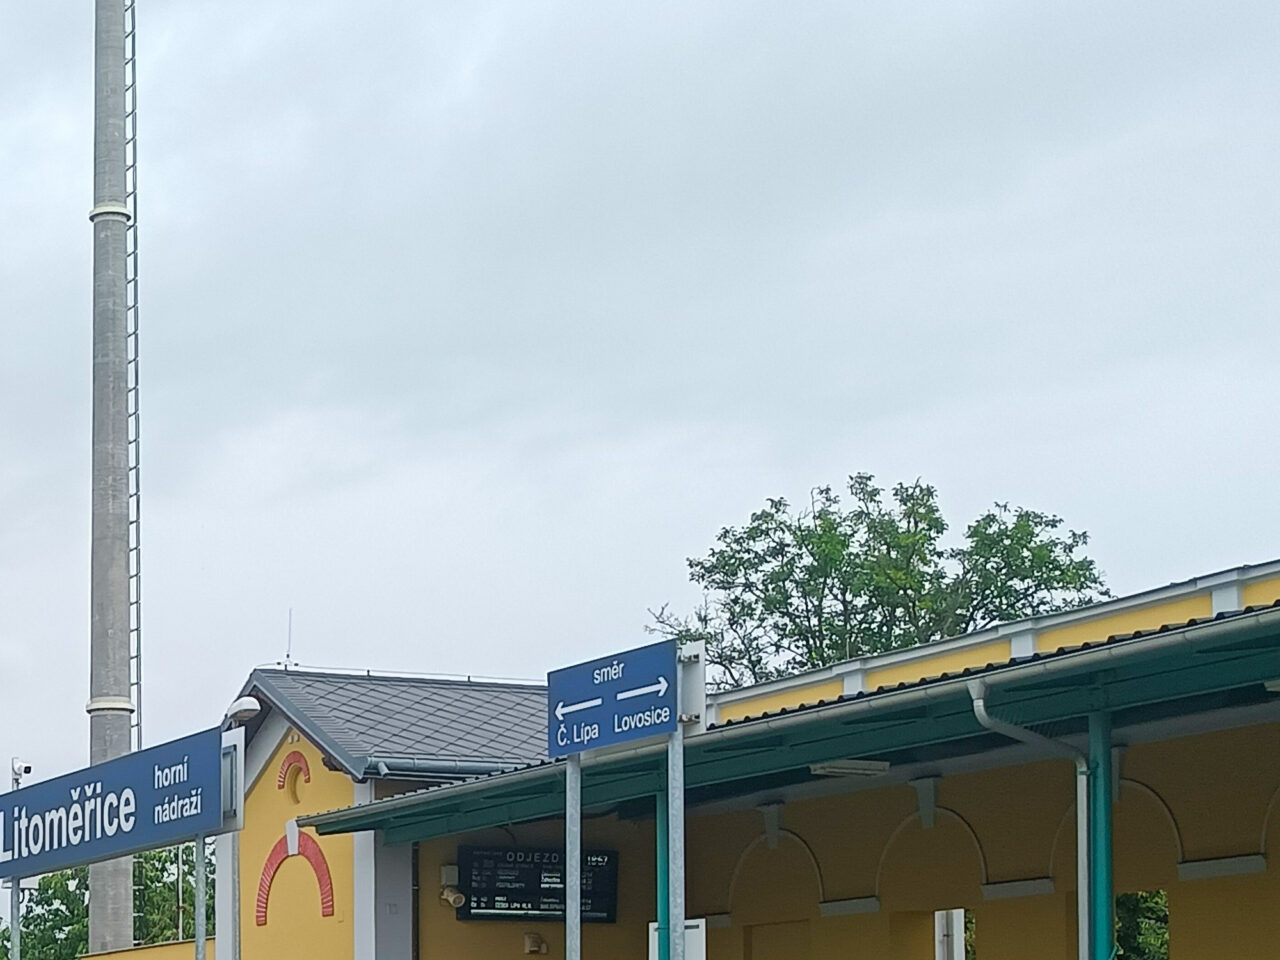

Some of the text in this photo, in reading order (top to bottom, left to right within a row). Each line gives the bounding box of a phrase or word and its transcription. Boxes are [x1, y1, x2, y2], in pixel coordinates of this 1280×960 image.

[593, 661, 624, 684] směr
[614, 706, 669, 732] Lovosice
[557, 721, 599, 747] Č. Lípa
[154, 756, 189, 790] horní
[154, 788, 203, 825] nádraží
